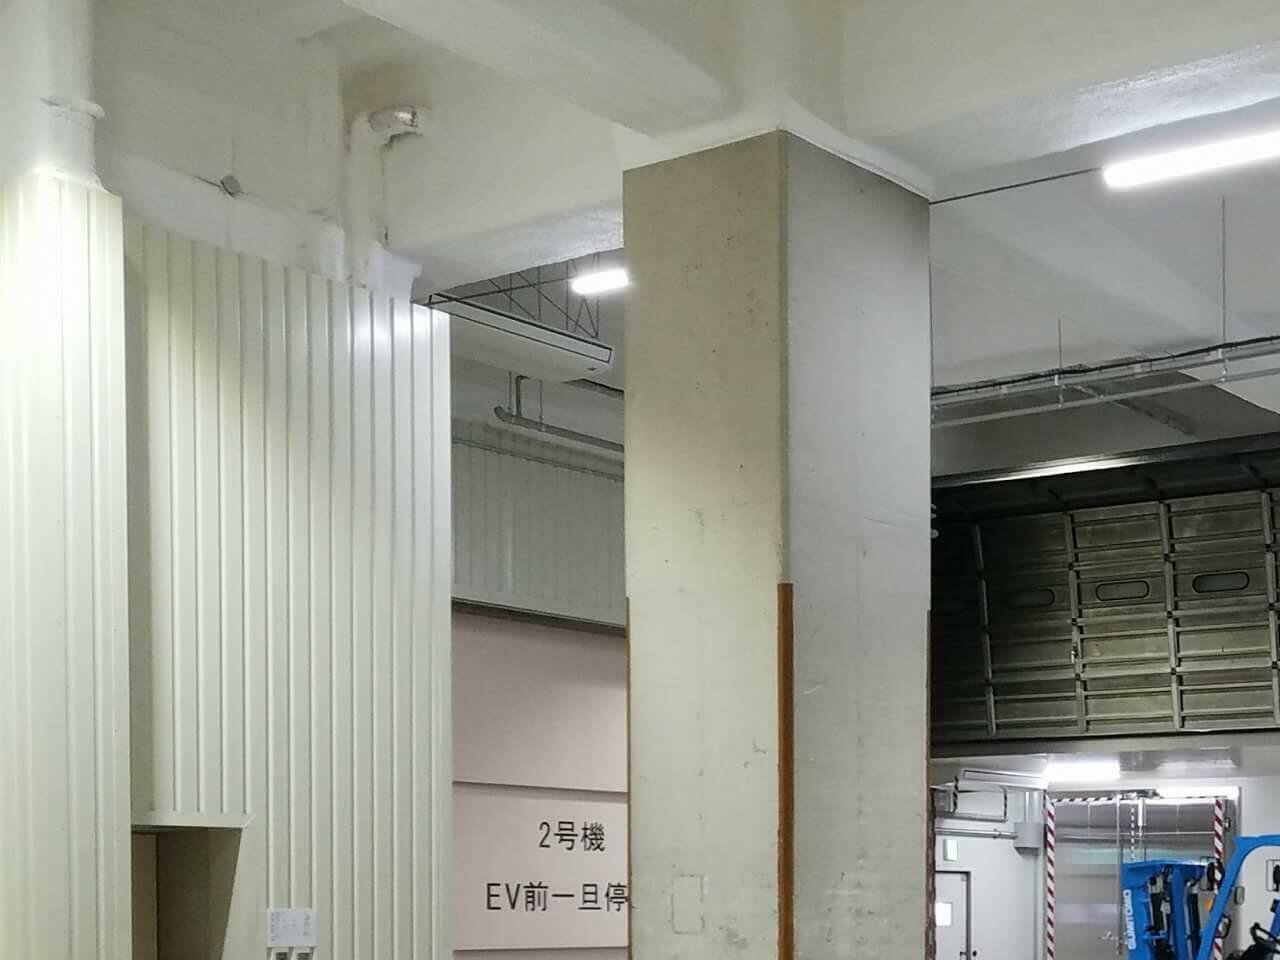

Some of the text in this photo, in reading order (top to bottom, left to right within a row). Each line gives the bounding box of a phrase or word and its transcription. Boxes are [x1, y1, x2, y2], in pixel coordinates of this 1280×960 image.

[538, 820, 606, 852] 2号機
[486, 881, 629, 912] EV前一旦停
